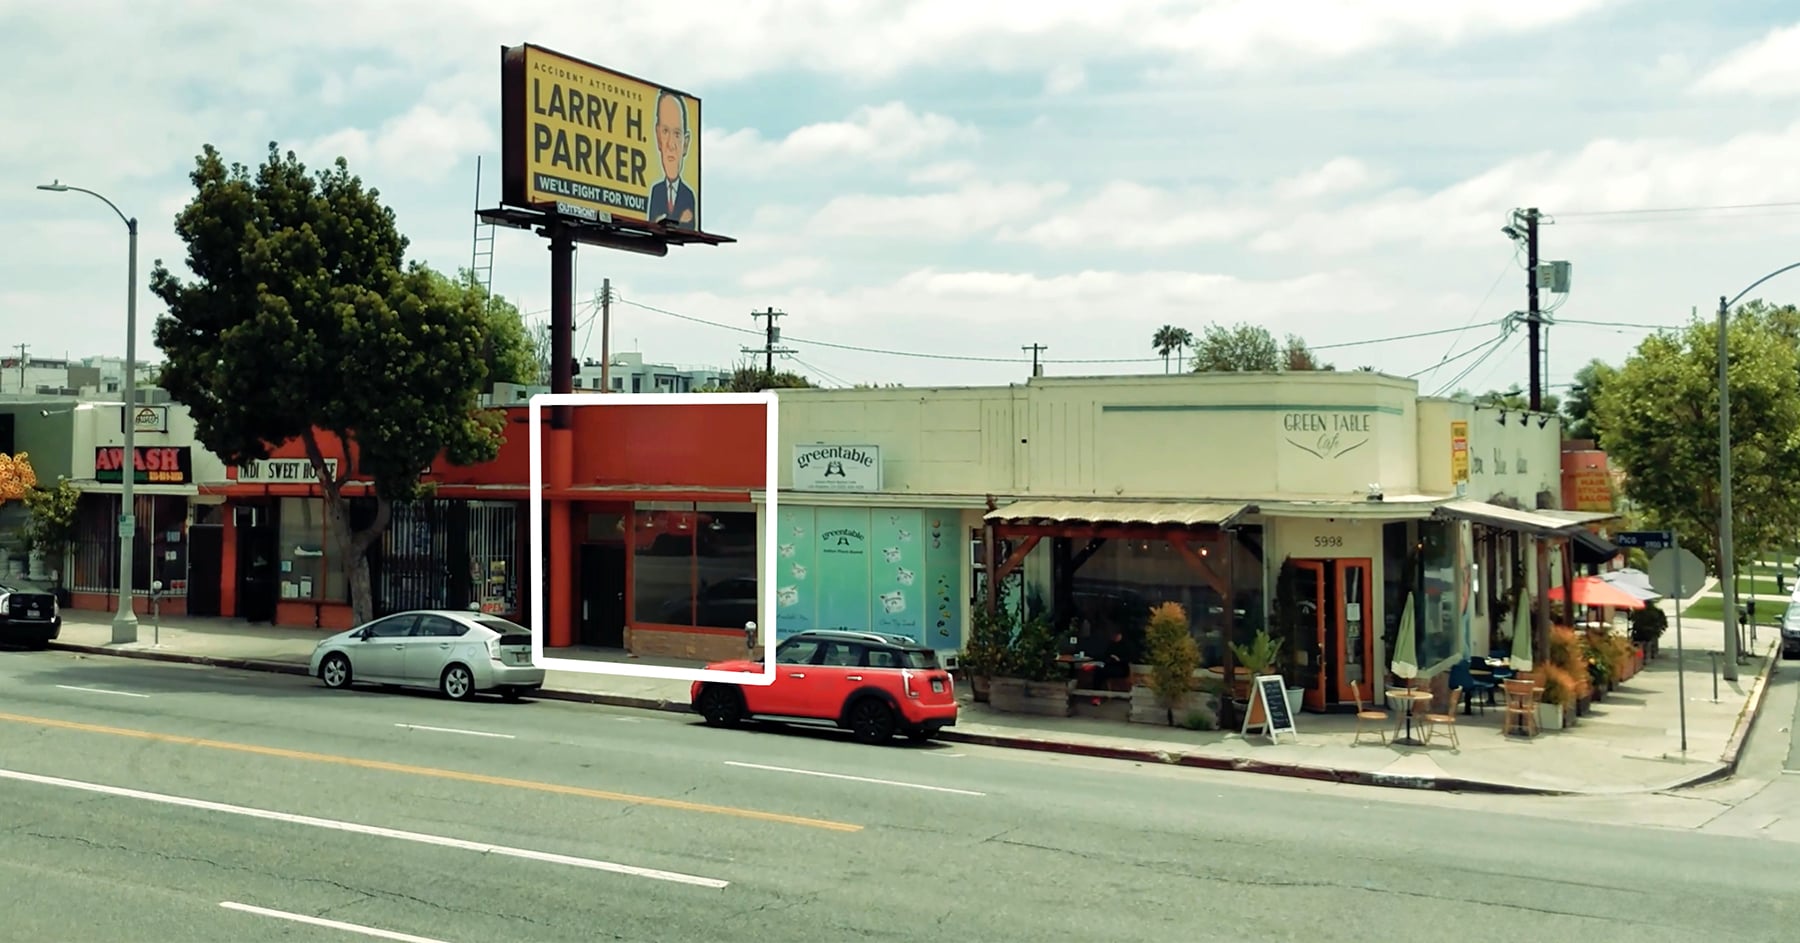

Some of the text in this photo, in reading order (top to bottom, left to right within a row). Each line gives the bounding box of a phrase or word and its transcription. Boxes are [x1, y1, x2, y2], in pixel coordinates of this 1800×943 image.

[534, 62, 642, 102] ACCIDENT ATTORNEYS
[534, 77, 647, 143] LARRY H.
[534, 121, 647, 188] PARKER
[539, 176, 645, 210] WE'LL FIGHT FOR YOU!
[1284, 413, 1370, 432] GREEN TABLE
[797, 446, 873, 469] greentable
[269, 462, 300, 479] SWEET
[1314, 535, 1343, 548] 5998
[1619, 534, 1637, 545] Pico
